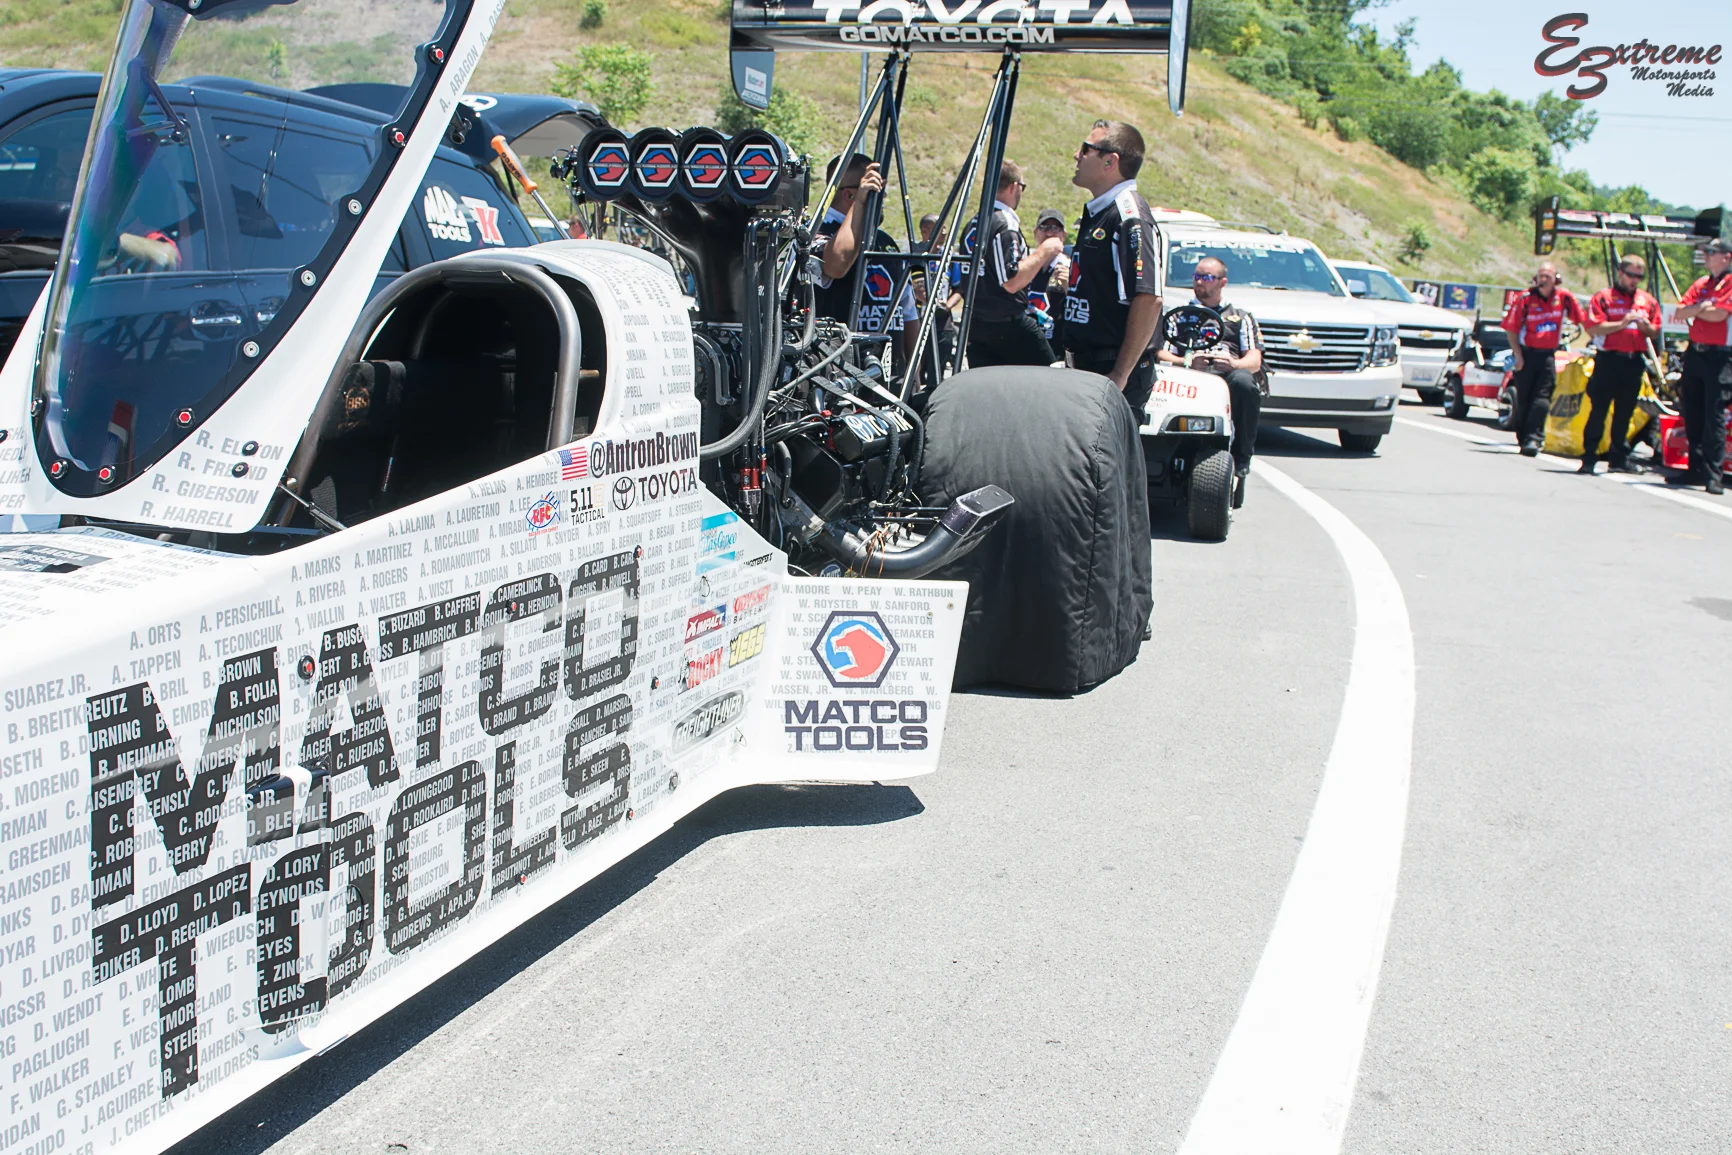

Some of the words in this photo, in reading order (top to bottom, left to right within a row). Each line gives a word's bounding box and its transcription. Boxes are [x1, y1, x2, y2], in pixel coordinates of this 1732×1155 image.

[839, 26, 1055, 44] GOMATCO.COM
[449, 45, 479, 96] ARAGON
[424, 186, 469, 229] MAC
[428, 222, 472, 243] TOOLS
[196, 429, 214, 449] R.
[202, 459, 268, 481] FREND
[590, 431, 698, 479] @AntronBrown
[176, 480, 259, 505] GIBERSON
[478, 479, 507, 497] HELMS
[526, 471, 558, 489] HEMBREE
[638, 469, 698, 501] TOYOTA
[456, 501, 500, 524] LAURETANO
[570, 487, 593, 513] 5.11
[163, 504, 233, 529] HARRELL
[399, 514, 436, 534] LALAINA
[571, 508, 605, 526] TACTICAL
[366, 542, 413, 566] MARTINEZ
[434, 528, 480, 551] MCCALLUM
[577, 541, 604, 559] BALLARD
[304, 556, 341, 579] MARKS
[431, 548, 491, 576] ROMANOWITCH
[474, 565, 509, 586] ZADIGIAN
[526, 552, 562, 572] ANDERSON
[591, 559, 608, 573] CARD
[309, 580, 346, 604] RIVERA
[372, 567, 409, 588] ROGERS
[795, 585, 831, 595] MOORE
[857, 586, 882, 596] PEAY
[370, 591, 407, 613] WALTER
[444, 593, 481, 619] CAFFREY
[527, 592, 559, 614] HERNDON
[814, 599, 858, 609] ROYSTER
[885, 600, 930, 611] SANFORD
[909, 587, 954, 599] RATHBUN
[148, 621, 182, 646] ORTS
[390, 609, 426, 633] BUZARD
[413, 622, 458, 650] HAMBRICK
[214, 624, 283, 658] TECONCHUK
[337, 625, 370, 648] BUSCH
[129, 650, 182, 680] TAPPEN
[218, 656, 261, 686] BROWN
[687, 647, 724, 690] ROCKY
[4, 679, 65, 712] SUAREZ
[67, 673, 91, 696] JR.
[159, 677, 189, 701] BRIL
[244, 679, 278, 705] FOLIA
[771, 684, 813, 696] VASSEN,
[816, 684, 832, 695] JR.
[860, 685, 914, 696] WAHLBERG
[28, 693, 128, 738] BREITKREUTZ
[172, 697, 216, 728] EMBRY
[215, 703, 280, 742] NICHOLSON
[493, 706, 517, 728] BRAND
[675, 694, 743, 743] FREIGHTLINER
[785, 700, 928, 724] MATCO
[78, 719, 141, 755] DURNING
[351, 714, 388, 742] HERZOG
[404, 716, 437, 742] SADLER
[580, 724, 607, 746] SANCHEZ
[785, 726, 929, 751] TOOLS
[116, 735, 183, 775] NEUMARK
[193, 738, 257, 775] ANDERSON
[348, 737, 385, 765] RUEDAS
[14, 768, 80, 807] MORENO
[222, 757, 274, 793] HADDOW
[84, 770, 161, 813] AISENBREY
[402, 774, 454, 810] LOVINGGOOD
[126, 787, 193, 827] GREENSLY
[178, 816, 193, 836] C.
[195, 793, 254, 830] RODGERS
[256, 789, 280, 809] JR.
[413, 795, 454, 828] ROOKAIRD
[446, 802, 482, 832] BINGHAM
[8, 824, 91, 871] GREENMAN
[105, 825, 165, 865] ROBBINS
[165, 836, 208, 869] BERRY
[232, 839, 278, 867] EVANS
[284, 853, 322, 878] LORY
[70, 865, 132, 908] BAUMAN
[142, 864, 204, 906] EDWARDS
[209, 872, 249, 904] LOPEZ
[250, 877, 324, 912] REYNOLDS
[137, 902, 179, 937] LLOYD
[171, 911, 219, 949] REGULA
[205, 915, 275, 959] WIEBUSCH
[246, 936, 293, 967] REYES
[41, 934, 104, 981] LIVRONE
[81, 946, 141, 991] REDIKER
[273, 953, 315, 983] ZINCK
[135, 956, 177, 992] WHITE
[52, 992, 104, 1033] WENDT
[242, 982, 305, 1018] STEVENS
[129, 983, 232, 1051] WESTMORELAND
[164, 1017, 213, 1060] STEIERT
[12, 1027, 91, 1084] PAGLIUGHI
[197, 1044, 260, 1094] CHILDRESS
[28, 1057, 90, 1104] WALKER
[75, 1060, 135, 1109] STANLEY
[97, 1077, 154, 1126] AGUIRRE
